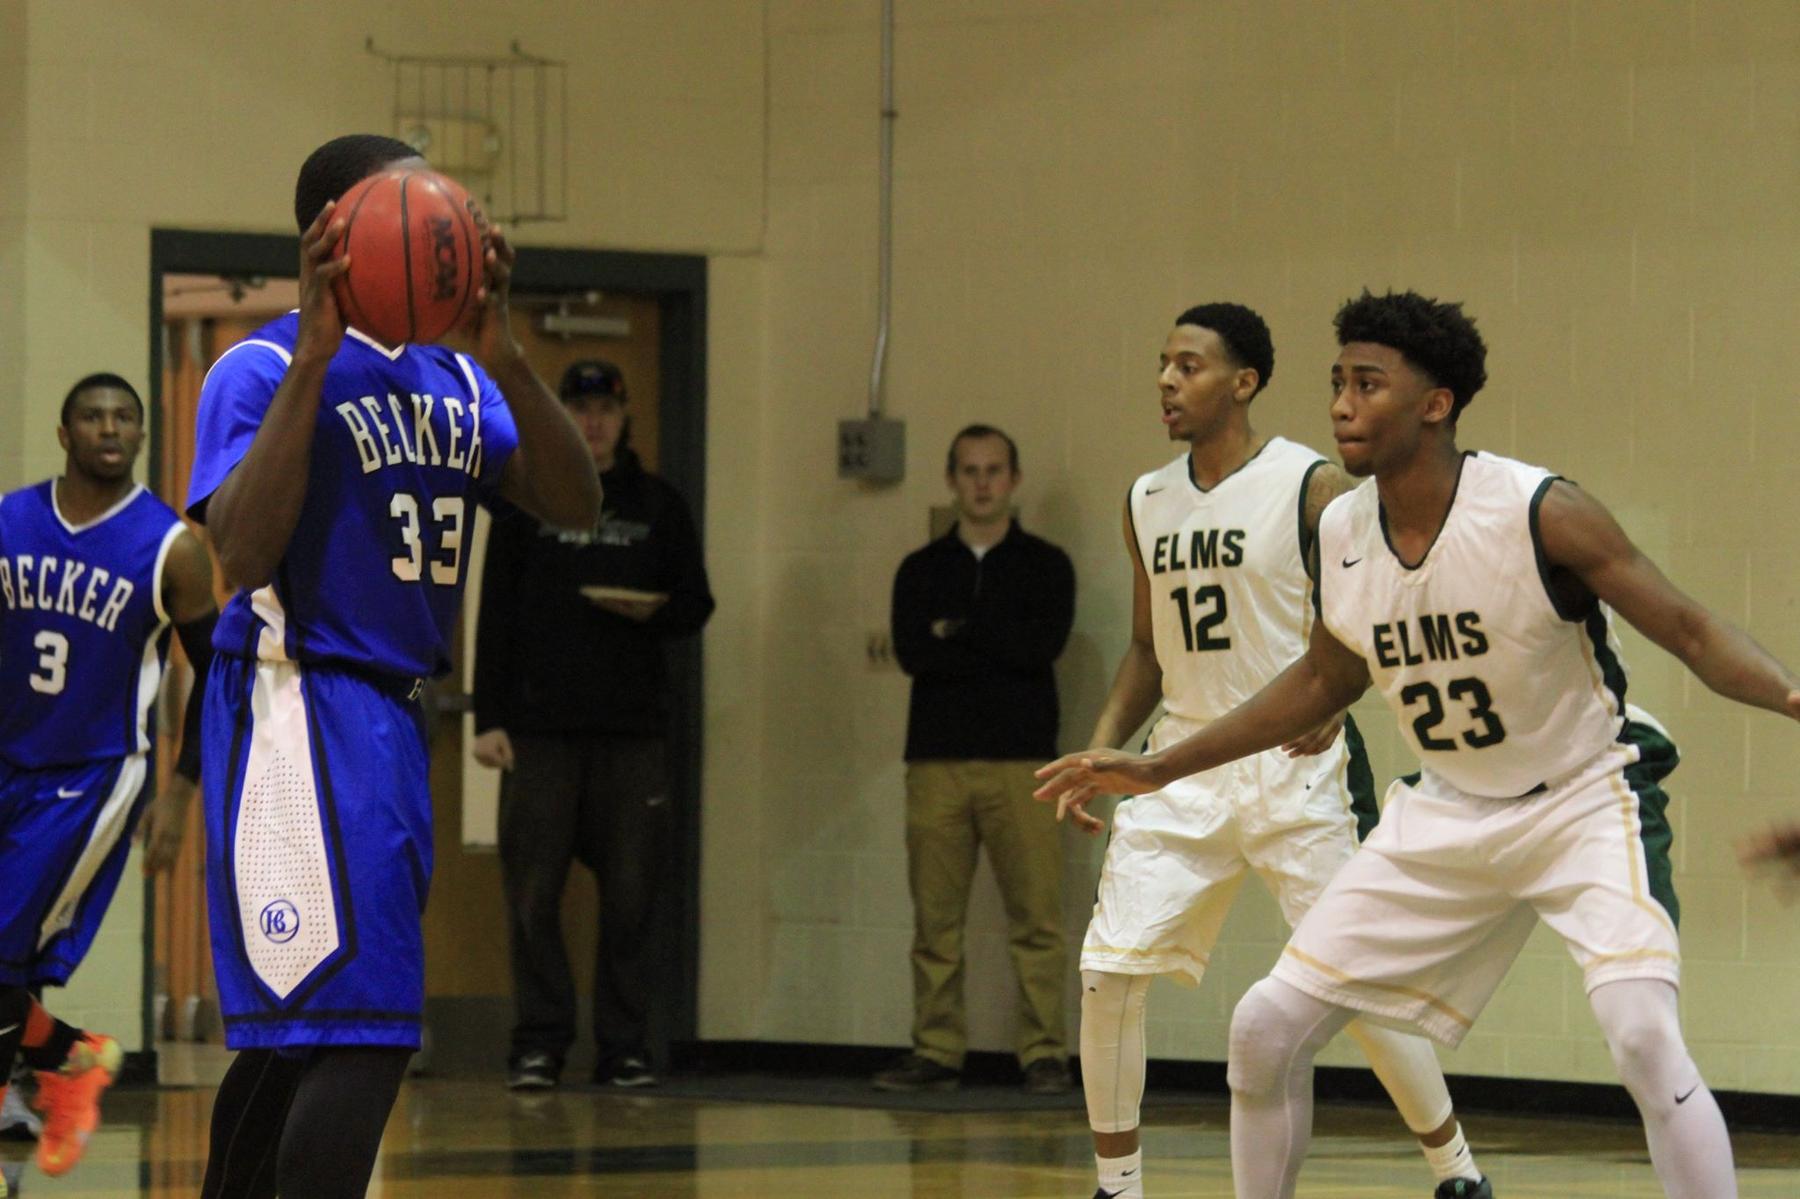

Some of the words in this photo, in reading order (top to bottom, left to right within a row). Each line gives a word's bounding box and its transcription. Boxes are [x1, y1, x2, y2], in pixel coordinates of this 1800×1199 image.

[390, 493, 464, 585] 33
[1153, 529, 1246, 575] ELMS
[1170, 584, 1231, 652] 12
[1373, 611, 1489, 668] ELMS
[29, 630, 69, 695] 3
[1401, 677, 1506, 751] 23
